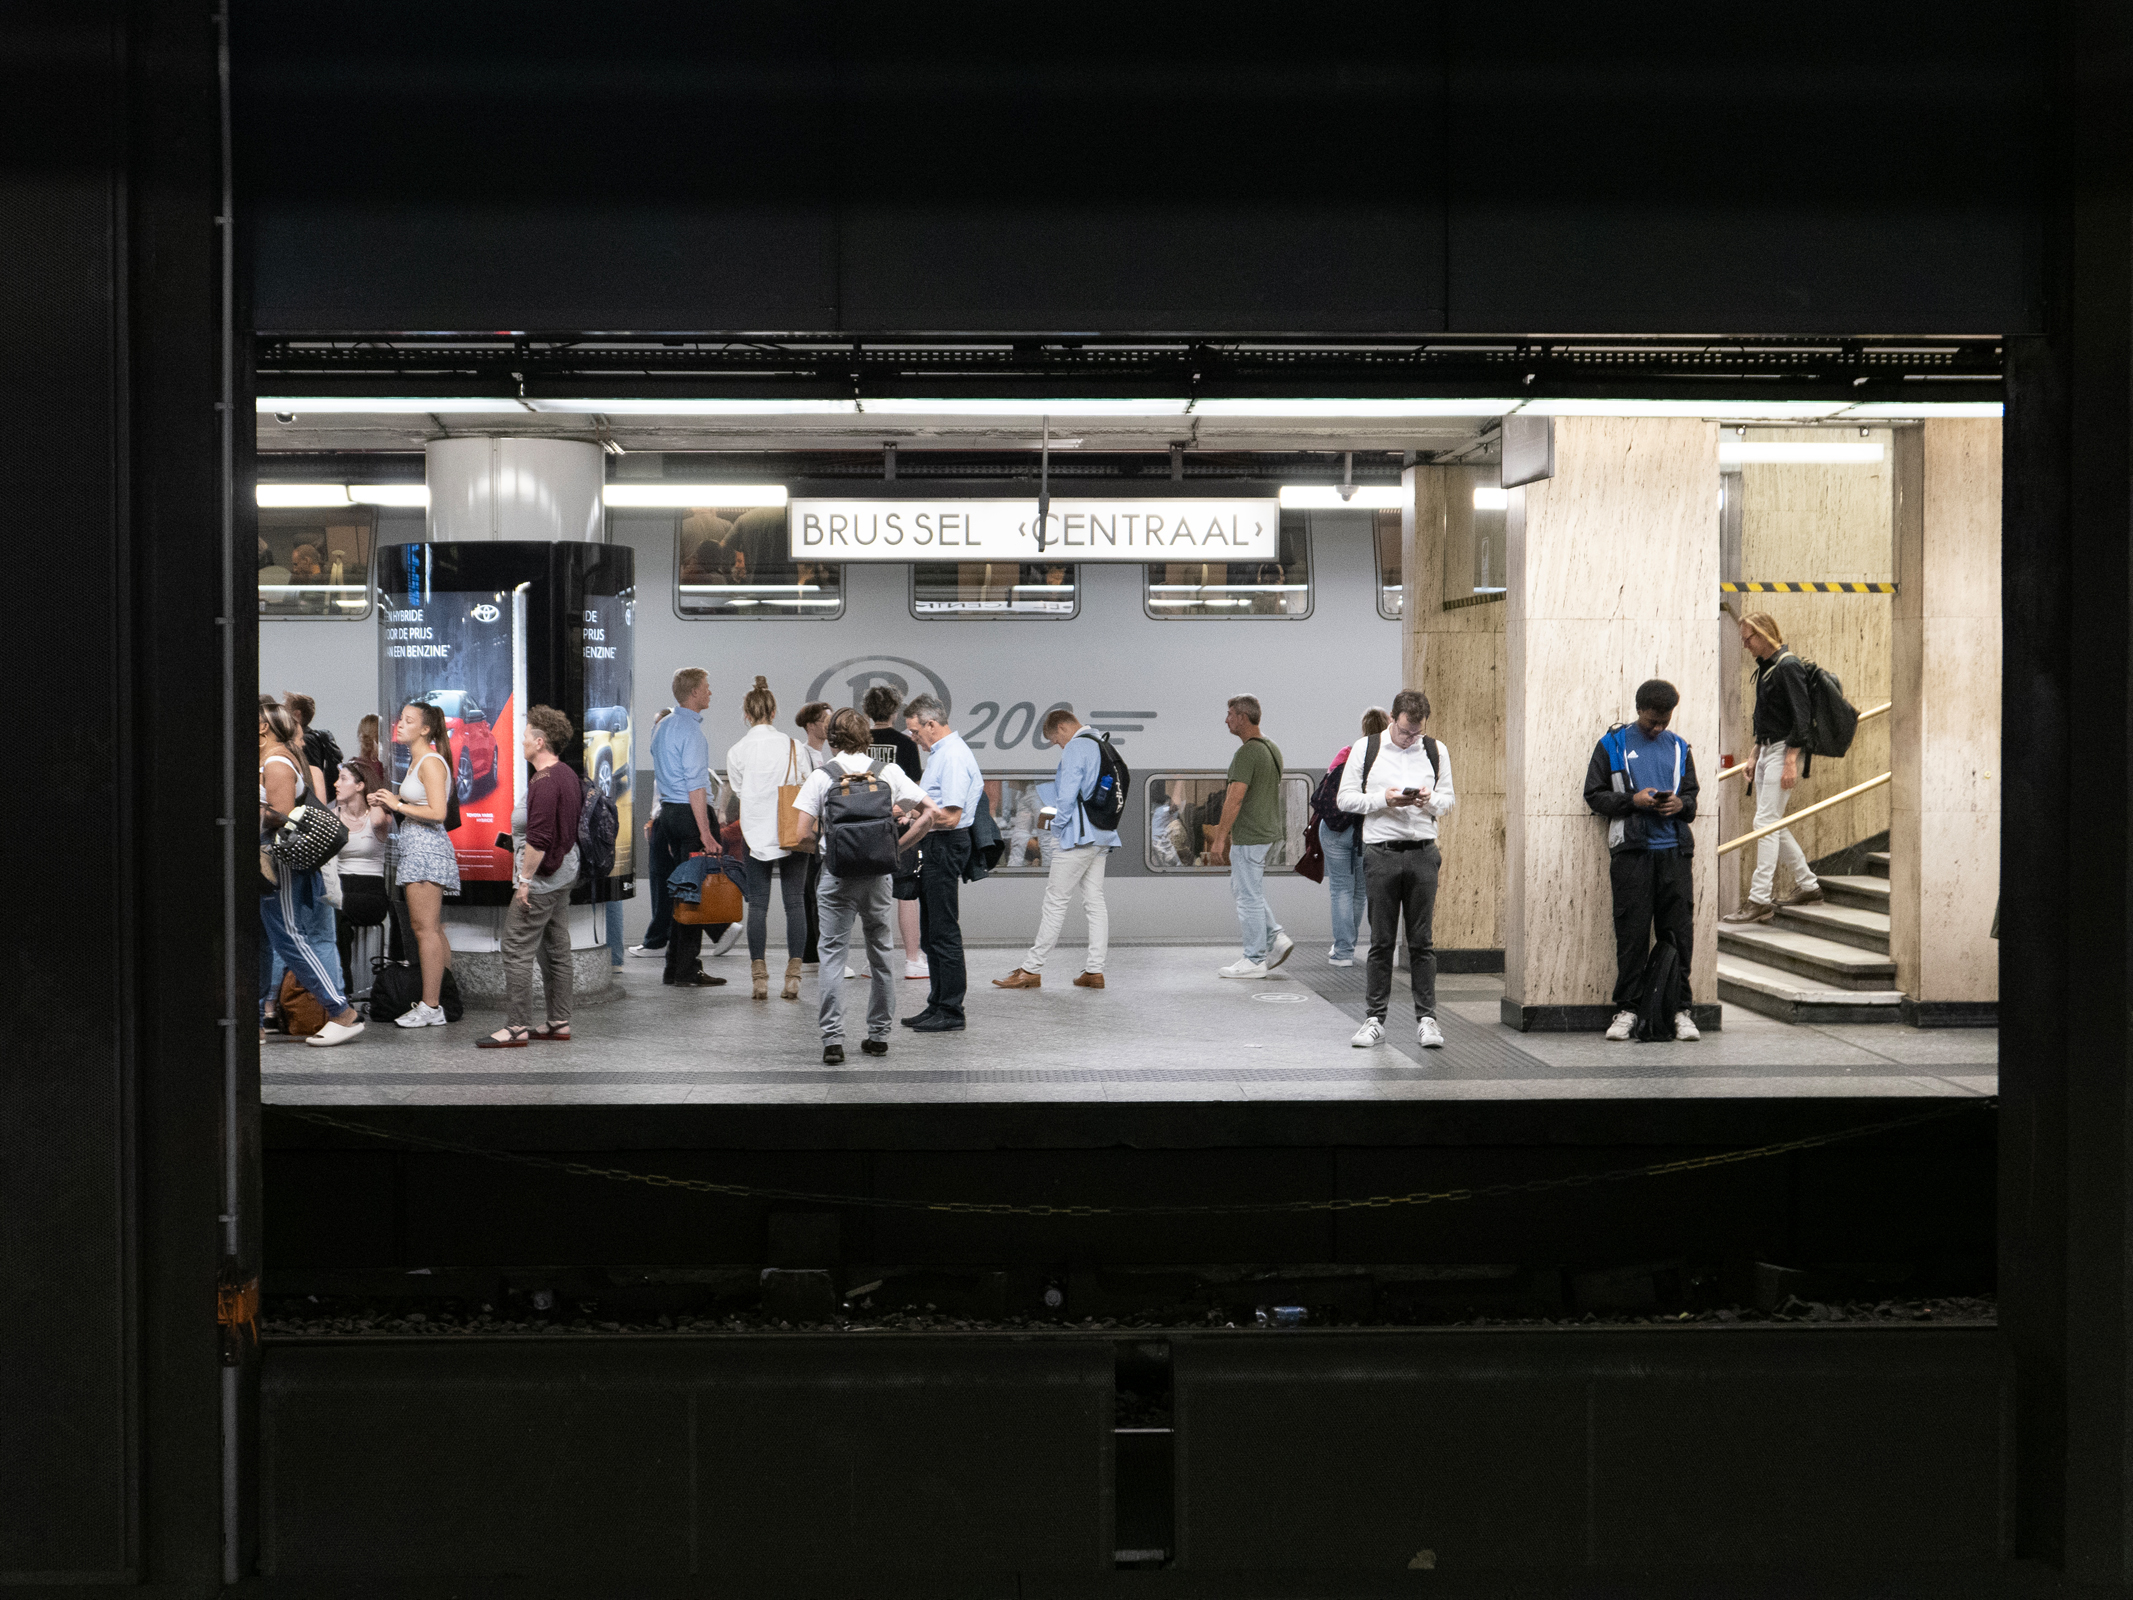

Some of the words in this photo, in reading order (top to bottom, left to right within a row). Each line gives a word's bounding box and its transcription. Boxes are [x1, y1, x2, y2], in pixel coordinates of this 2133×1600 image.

[803, 513, 982, 546] BRUSSEL
[393, 609, 423, 622] HYBRIDE
[399, 628, 408, 640] DE
[409, 627, 433, 640] PRIJS
[583, 628, 605, 641] PRIJS
[394, 646, 406, 658] EEN
